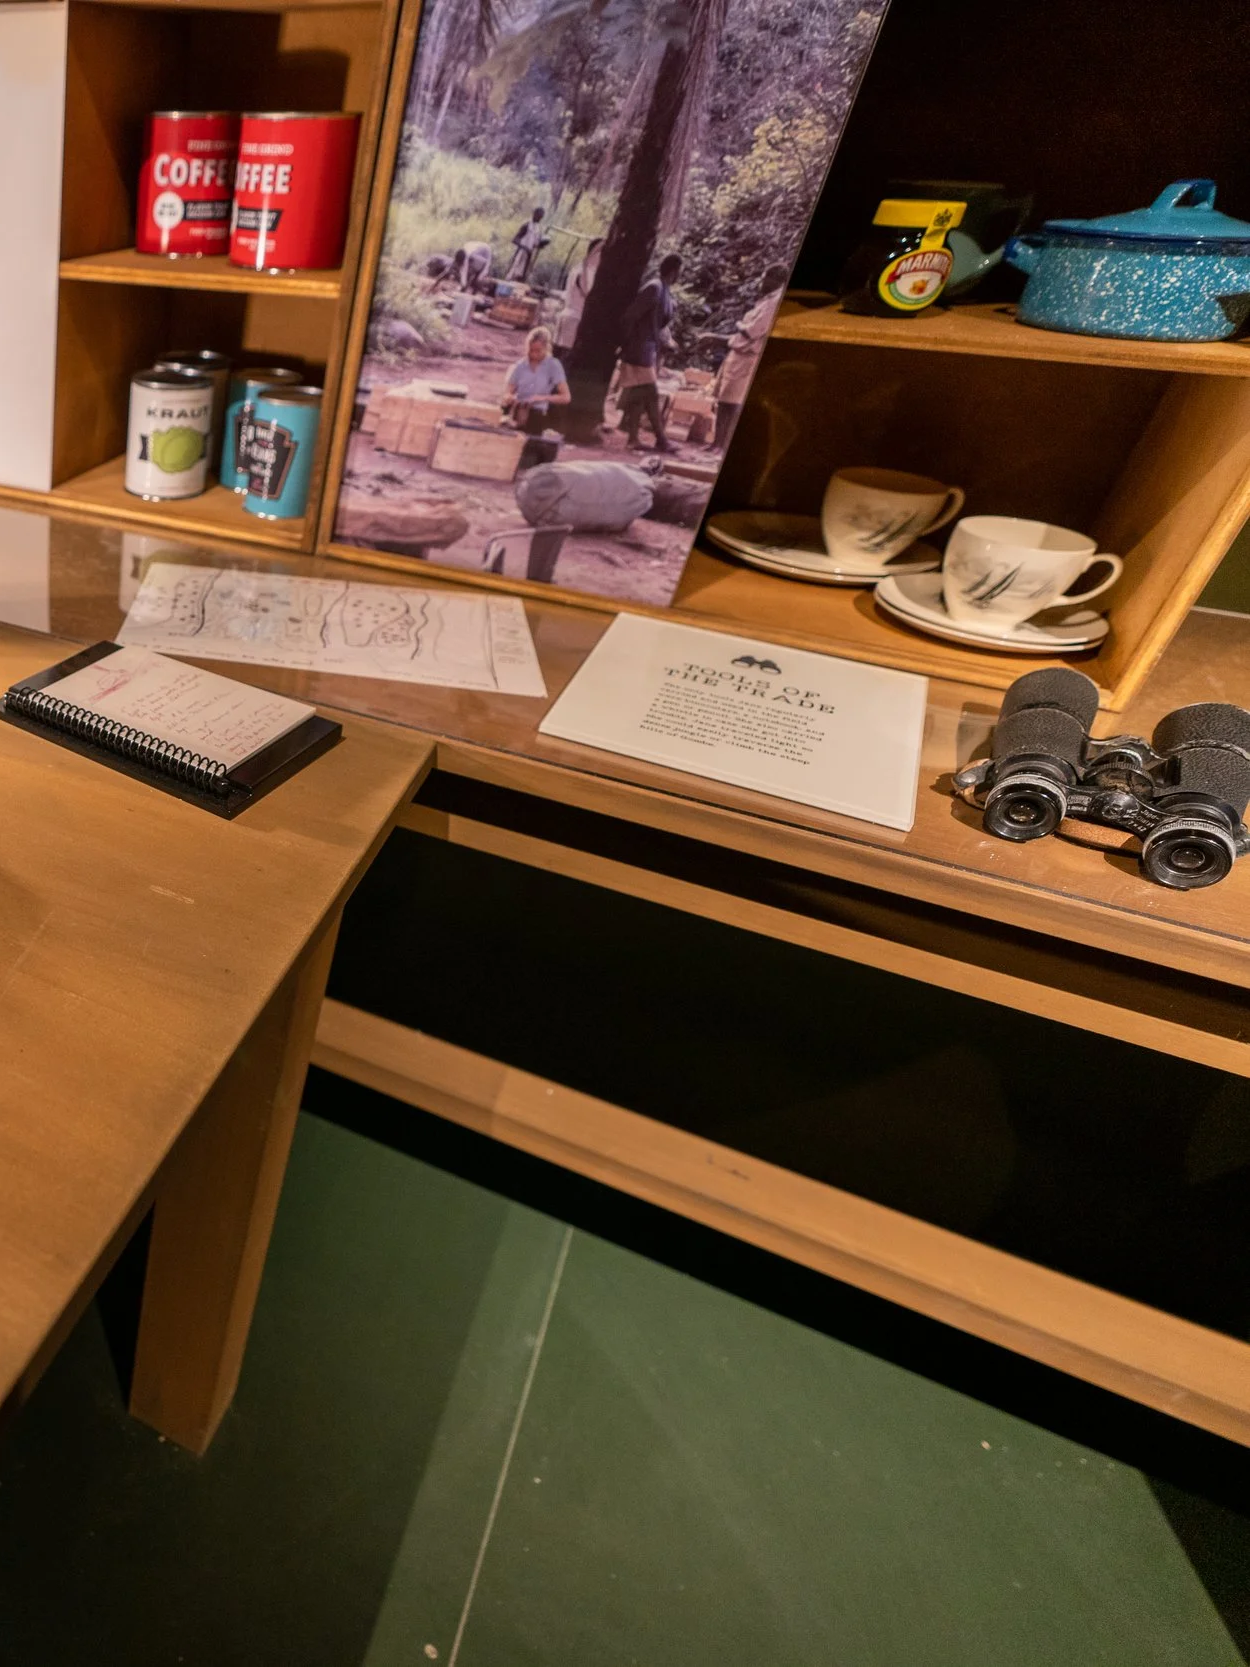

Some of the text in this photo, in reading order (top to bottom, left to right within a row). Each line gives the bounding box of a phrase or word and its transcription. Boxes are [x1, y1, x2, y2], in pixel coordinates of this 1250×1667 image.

[153, 152, 227, 188] COFFE
[664, 667, 836, 714] THE TRADE
[684, 663, 821, 699] TOOLS OF
